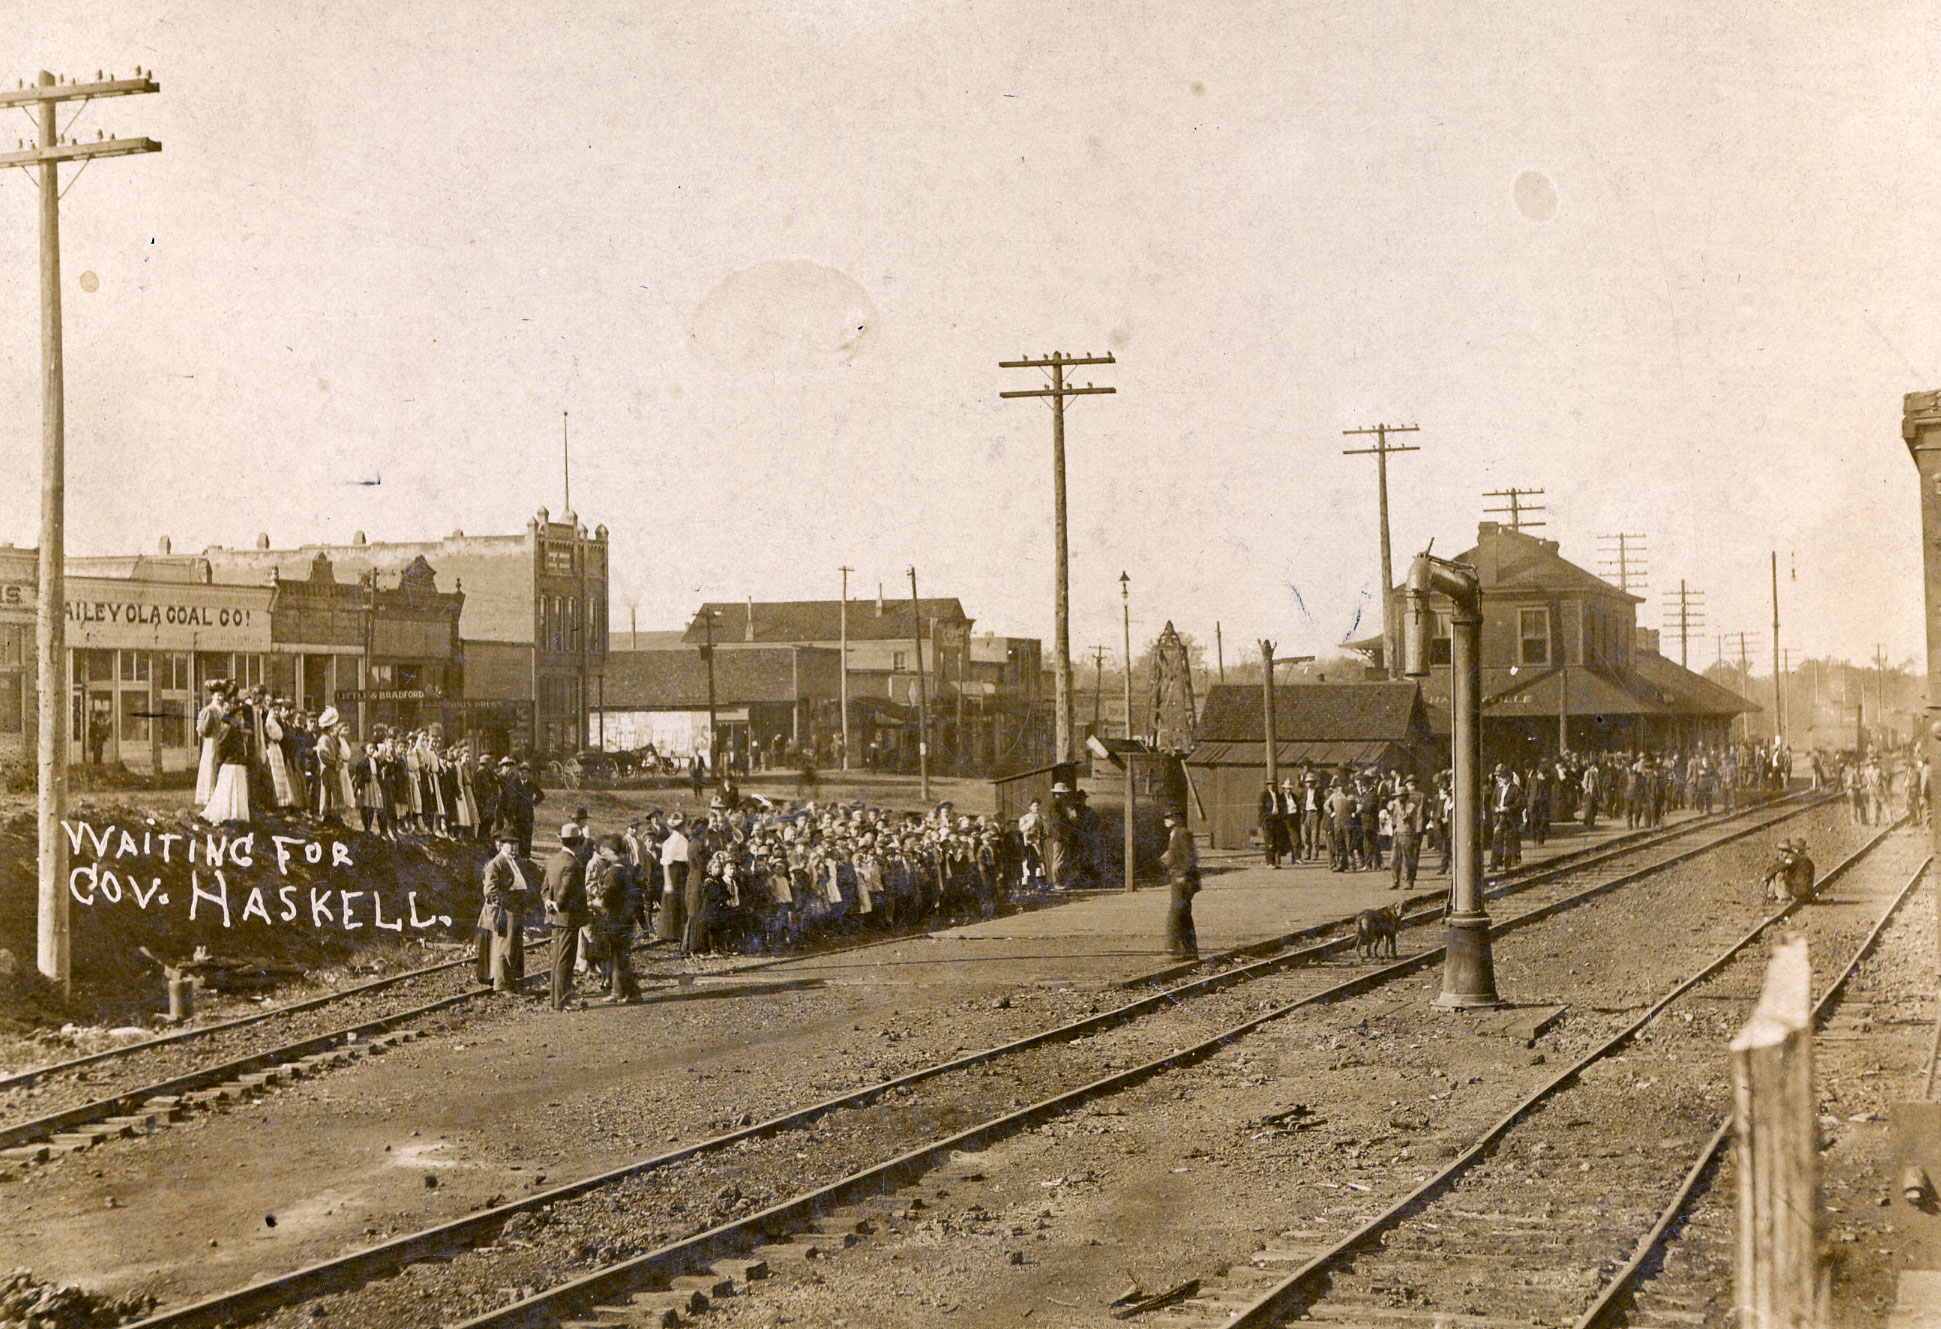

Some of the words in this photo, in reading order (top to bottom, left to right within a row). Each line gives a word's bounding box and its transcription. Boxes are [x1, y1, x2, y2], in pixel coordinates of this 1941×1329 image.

[65, 601, 121, 622] AILEY
[125, 603, 162, 624] OLA
[166, 605, 213, 627] COAL
[379, 690, 425, 700] BRADFORD
